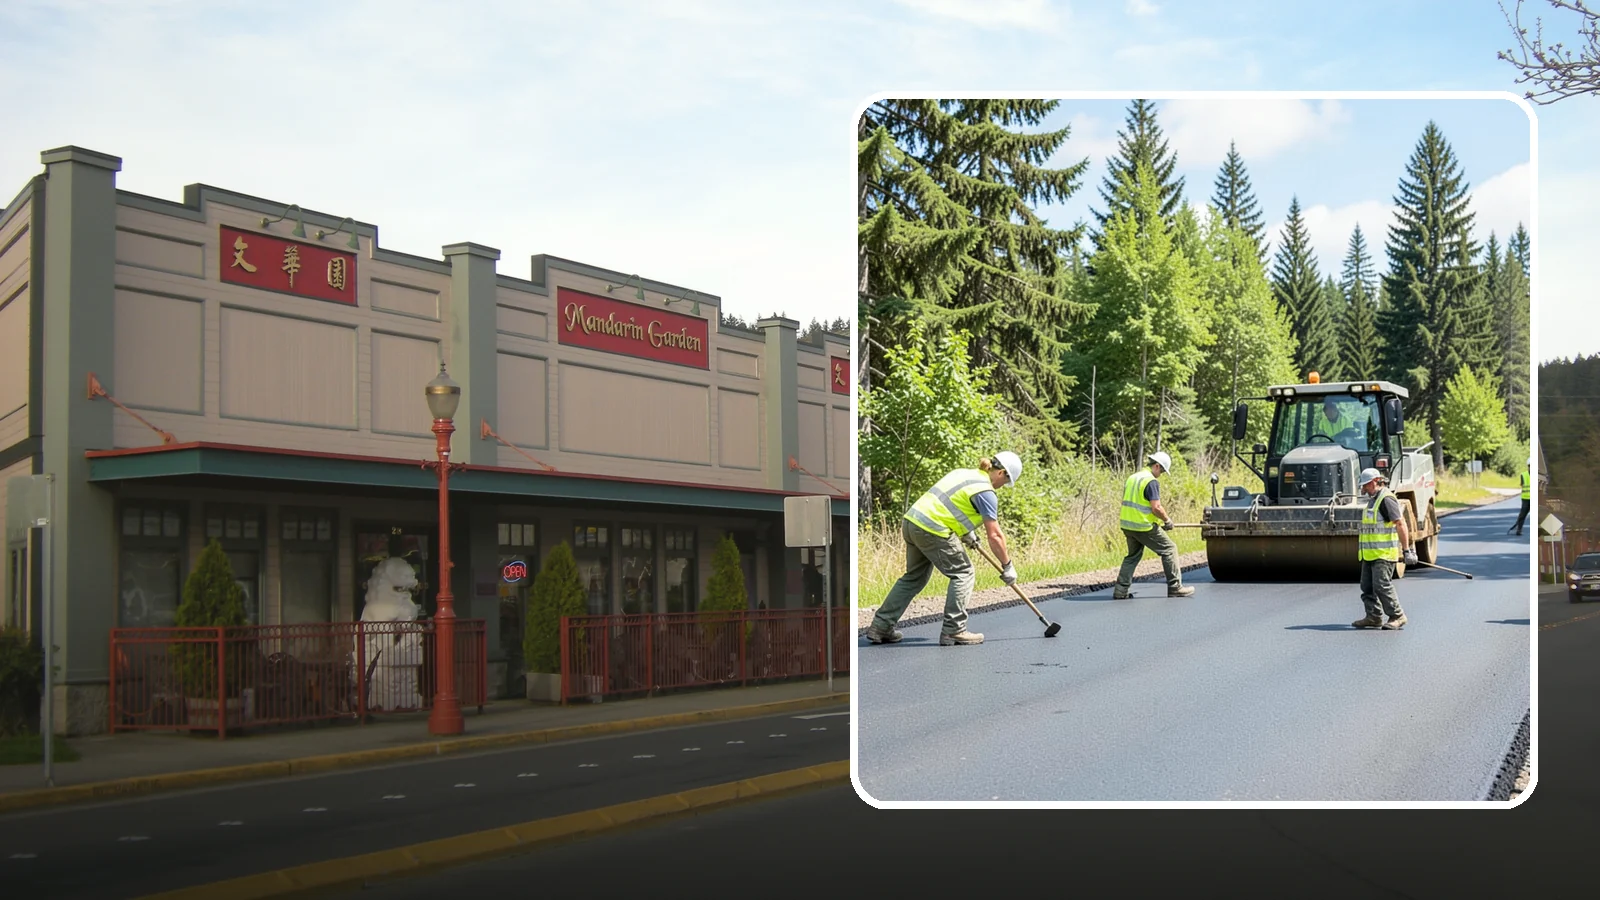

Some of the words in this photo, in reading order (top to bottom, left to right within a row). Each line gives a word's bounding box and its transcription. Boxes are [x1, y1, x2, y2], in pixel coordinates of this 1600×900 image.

[231, 236, 346, 291] 文華園
[565, 302, 644, 341] Mandarin
[648, 320, 702, 352] Garden
[503, 565, 527, 578] OPEN
